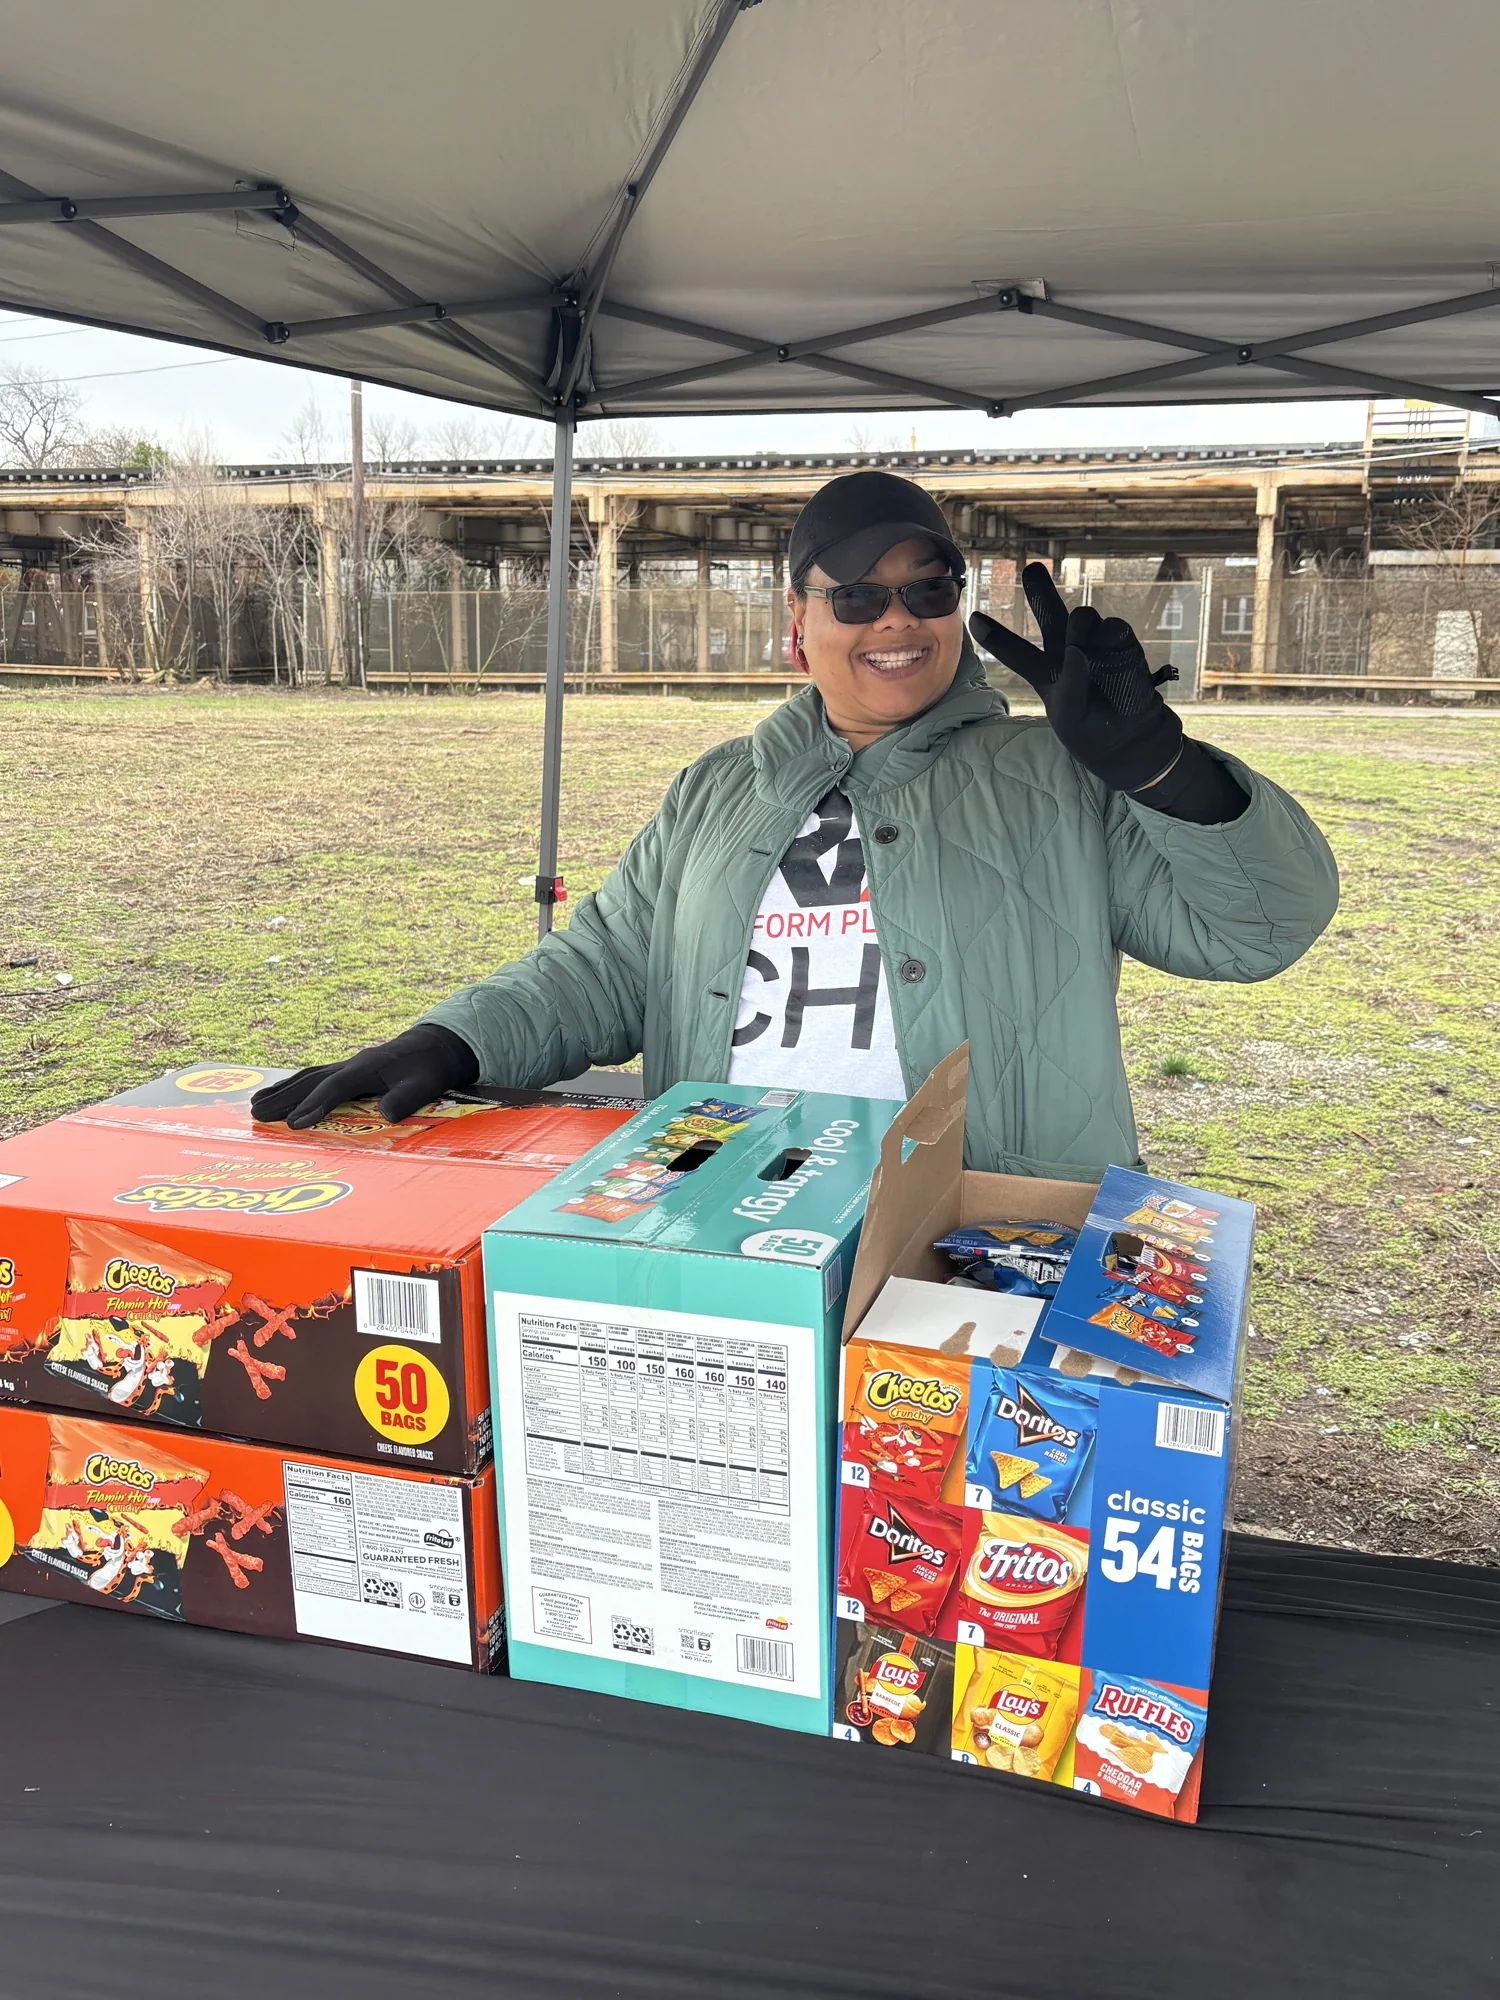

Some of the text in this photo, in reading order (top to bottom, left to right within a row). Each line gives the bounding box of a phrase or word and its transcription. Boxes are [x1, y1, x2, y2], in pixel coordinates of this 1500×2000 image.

[187, 1075, 244, 1091] 50
[804, 1119, 860, 1154] cool
[115, 1181, 353, 1214] Cheetos
[732, 1169, 823, 1223] tangy
[758, 1234, 783, 1252] BAGS
[774, 1237, 824, 1257] 50
[105, 1258, 176, 1296] Cheetos
[106, 1296, 147, 1312] Flamin'
[147, 1296, 169, 1309] Hot
[521, 1317, 554, 1329] Nutrition
[556, 1321, 577, 1331] Facts
[522, 1349, 554, 1360] Calories
[588, 1355, 607, 1367] 150
[617, 1359, 636, 1371] 100
[646, 1363, 665, 1375] 150
[675, 1367, 694, 1379] 160
[51, 1362, 109, 1393] CHEESE FLAVORED SNACKS
[375, 1358, 428, 1414] 50
[705, 1371, 724, 1383] 160
[735, 1375, 755, 1387] 150
[766, 1379, 786, 1391] 140
[867, 1371, 960, 1415] Cheetos
[380, 1410, 427, 1432] BAGS
[889, 1406, 933, 1424] Crunchy
[997, 1397, 1080, 1448] Doritos
[376, 1442, 434, 1461] CHEESE FLAVORED SNACKS
[1051, 1448, 1069, 1459] COOL
[86, 1454, 155, 1491] Cheetos
[287, 1465, 350, 1481] Nutrition Facts
[851, 1465, 865, 1481] 12
[86, 1490, 127, 1504] Flamin'
[128, 1491, 151, 1503] Hot
[289, 1490, 351, 1506] Calories 160
[975, 1488, 984, 1502] 7
[1107, 1489, 1206, 1525] classic
[869, 1516, 946, 1565] Doritos
[363, 1553, 459, 1567] GUARANTEED FRESH
[979, 1538, 1073, 1586] Fritos
[1100, 1516, 1204, 1594] 54 BAGS
[31, 1549, 89, 1580] CHEESE FLAVORED SNACKS
[912, 1568, 936, 1583] CHEESE
[847, 1600, 860, 1615] 12
[978, 1607, 1041, 1625] The ORIGINAL
[967, 1625, 976, 1639] 7
[876, 1660, 920, 1688] Lay's
[996, 1689, 1041, 1717] Lay's
[1098, 1687, 1191, 1740] RUFFLES
[844, 1728, 852, 1741] 4
[995, 1722, 1020, 1738] CLASSIC
[1100, 1762, 1143, 1790] CHEDDAR
[1102, 1773, 1118, 1786] SOUR
[1117, 1781, 1138, 1796] CREAM
[1083, 1781, 1091, 1794] 4
